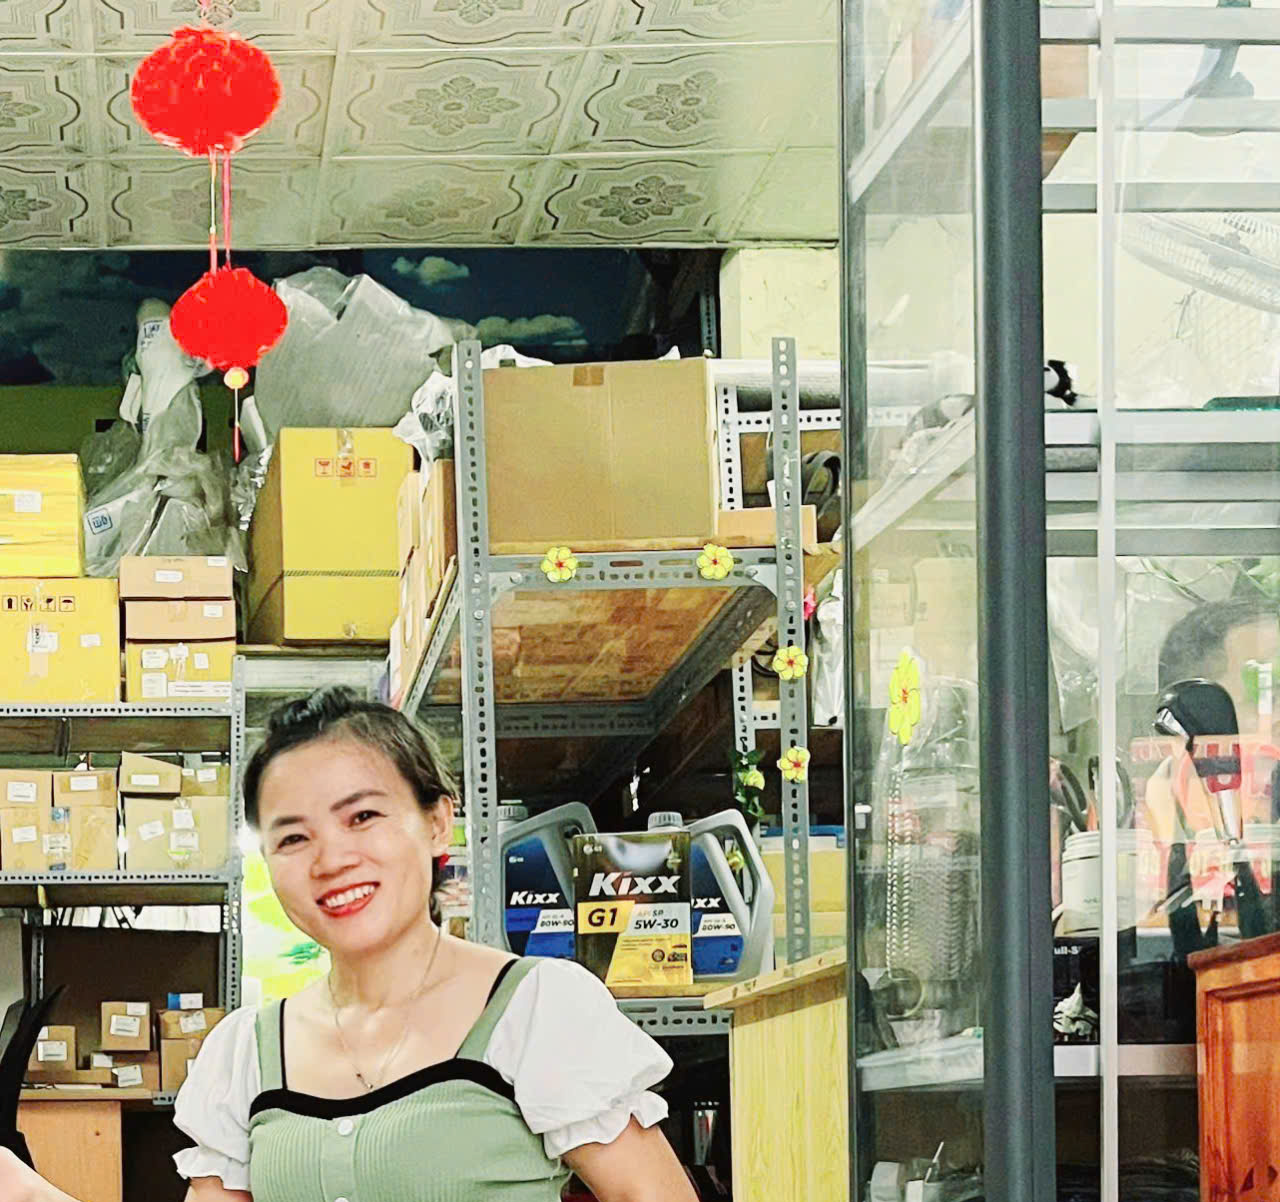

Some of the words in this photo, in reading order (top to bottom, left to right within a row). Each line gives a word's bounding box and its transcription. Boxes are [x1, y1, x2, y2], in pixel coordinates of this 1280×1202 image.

[589, 871, 681, 897] Kixx
[510, 890, 561, 906] Kixx
[587, 907, 618, 927] G1
[634, 917, 679, 930] 5W-30
